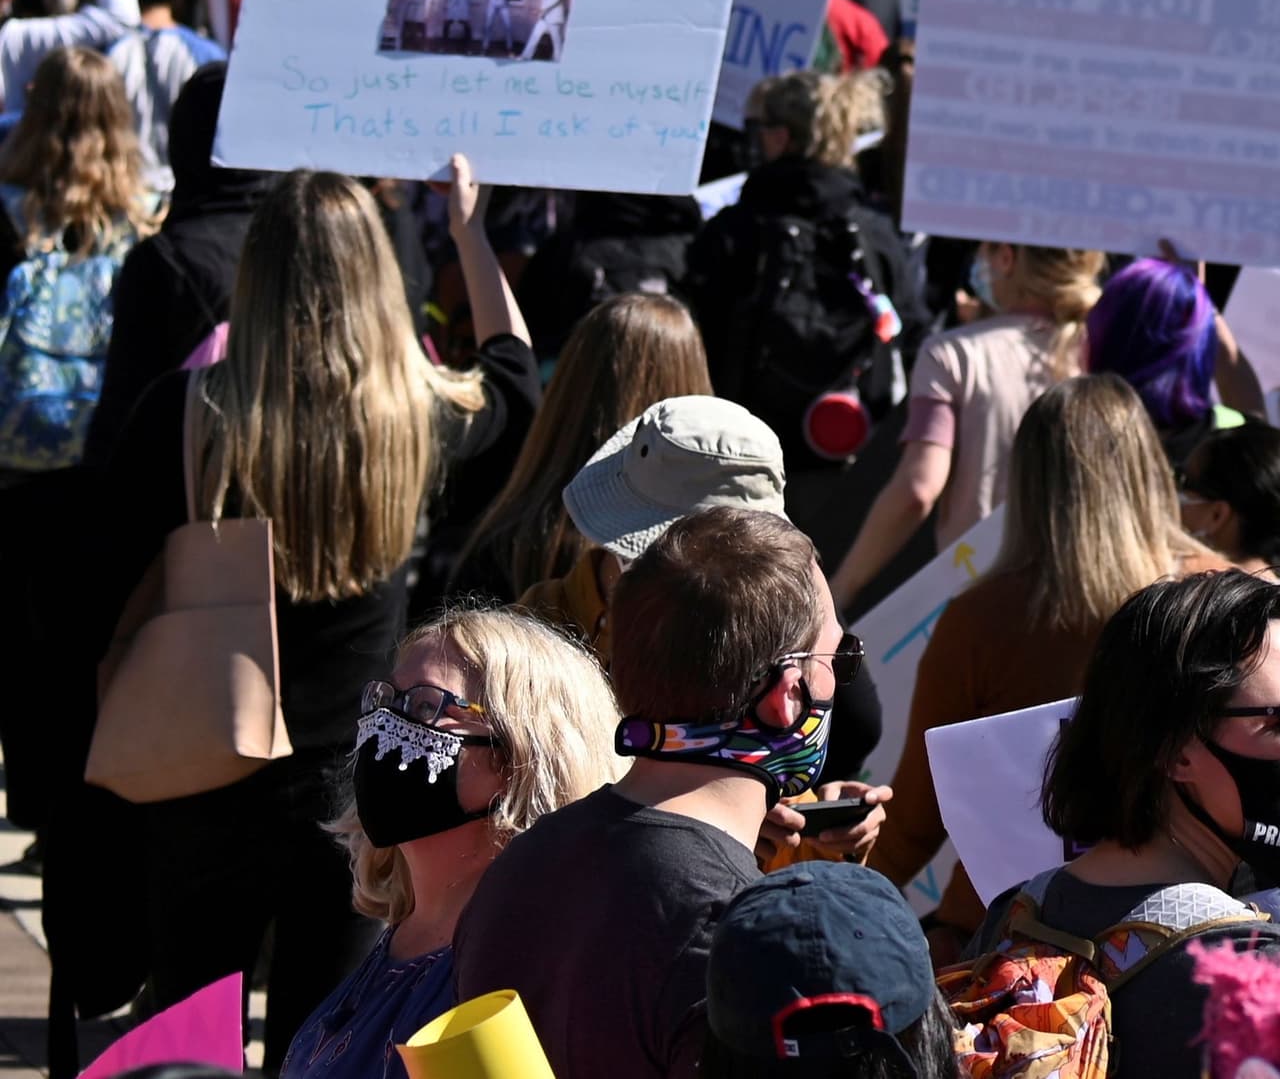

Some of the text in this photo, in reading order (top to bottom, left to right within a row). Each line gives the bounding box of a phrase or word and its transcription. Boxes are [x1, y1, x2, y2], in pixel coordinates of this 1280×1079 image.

[282, 54, 711, 106] So just let me be myself
[435, 110, 481, 137] all
[493, 109, 524, 137] I
[537, 114, 591, 138] ask
[607, 116, 641, 139] of
